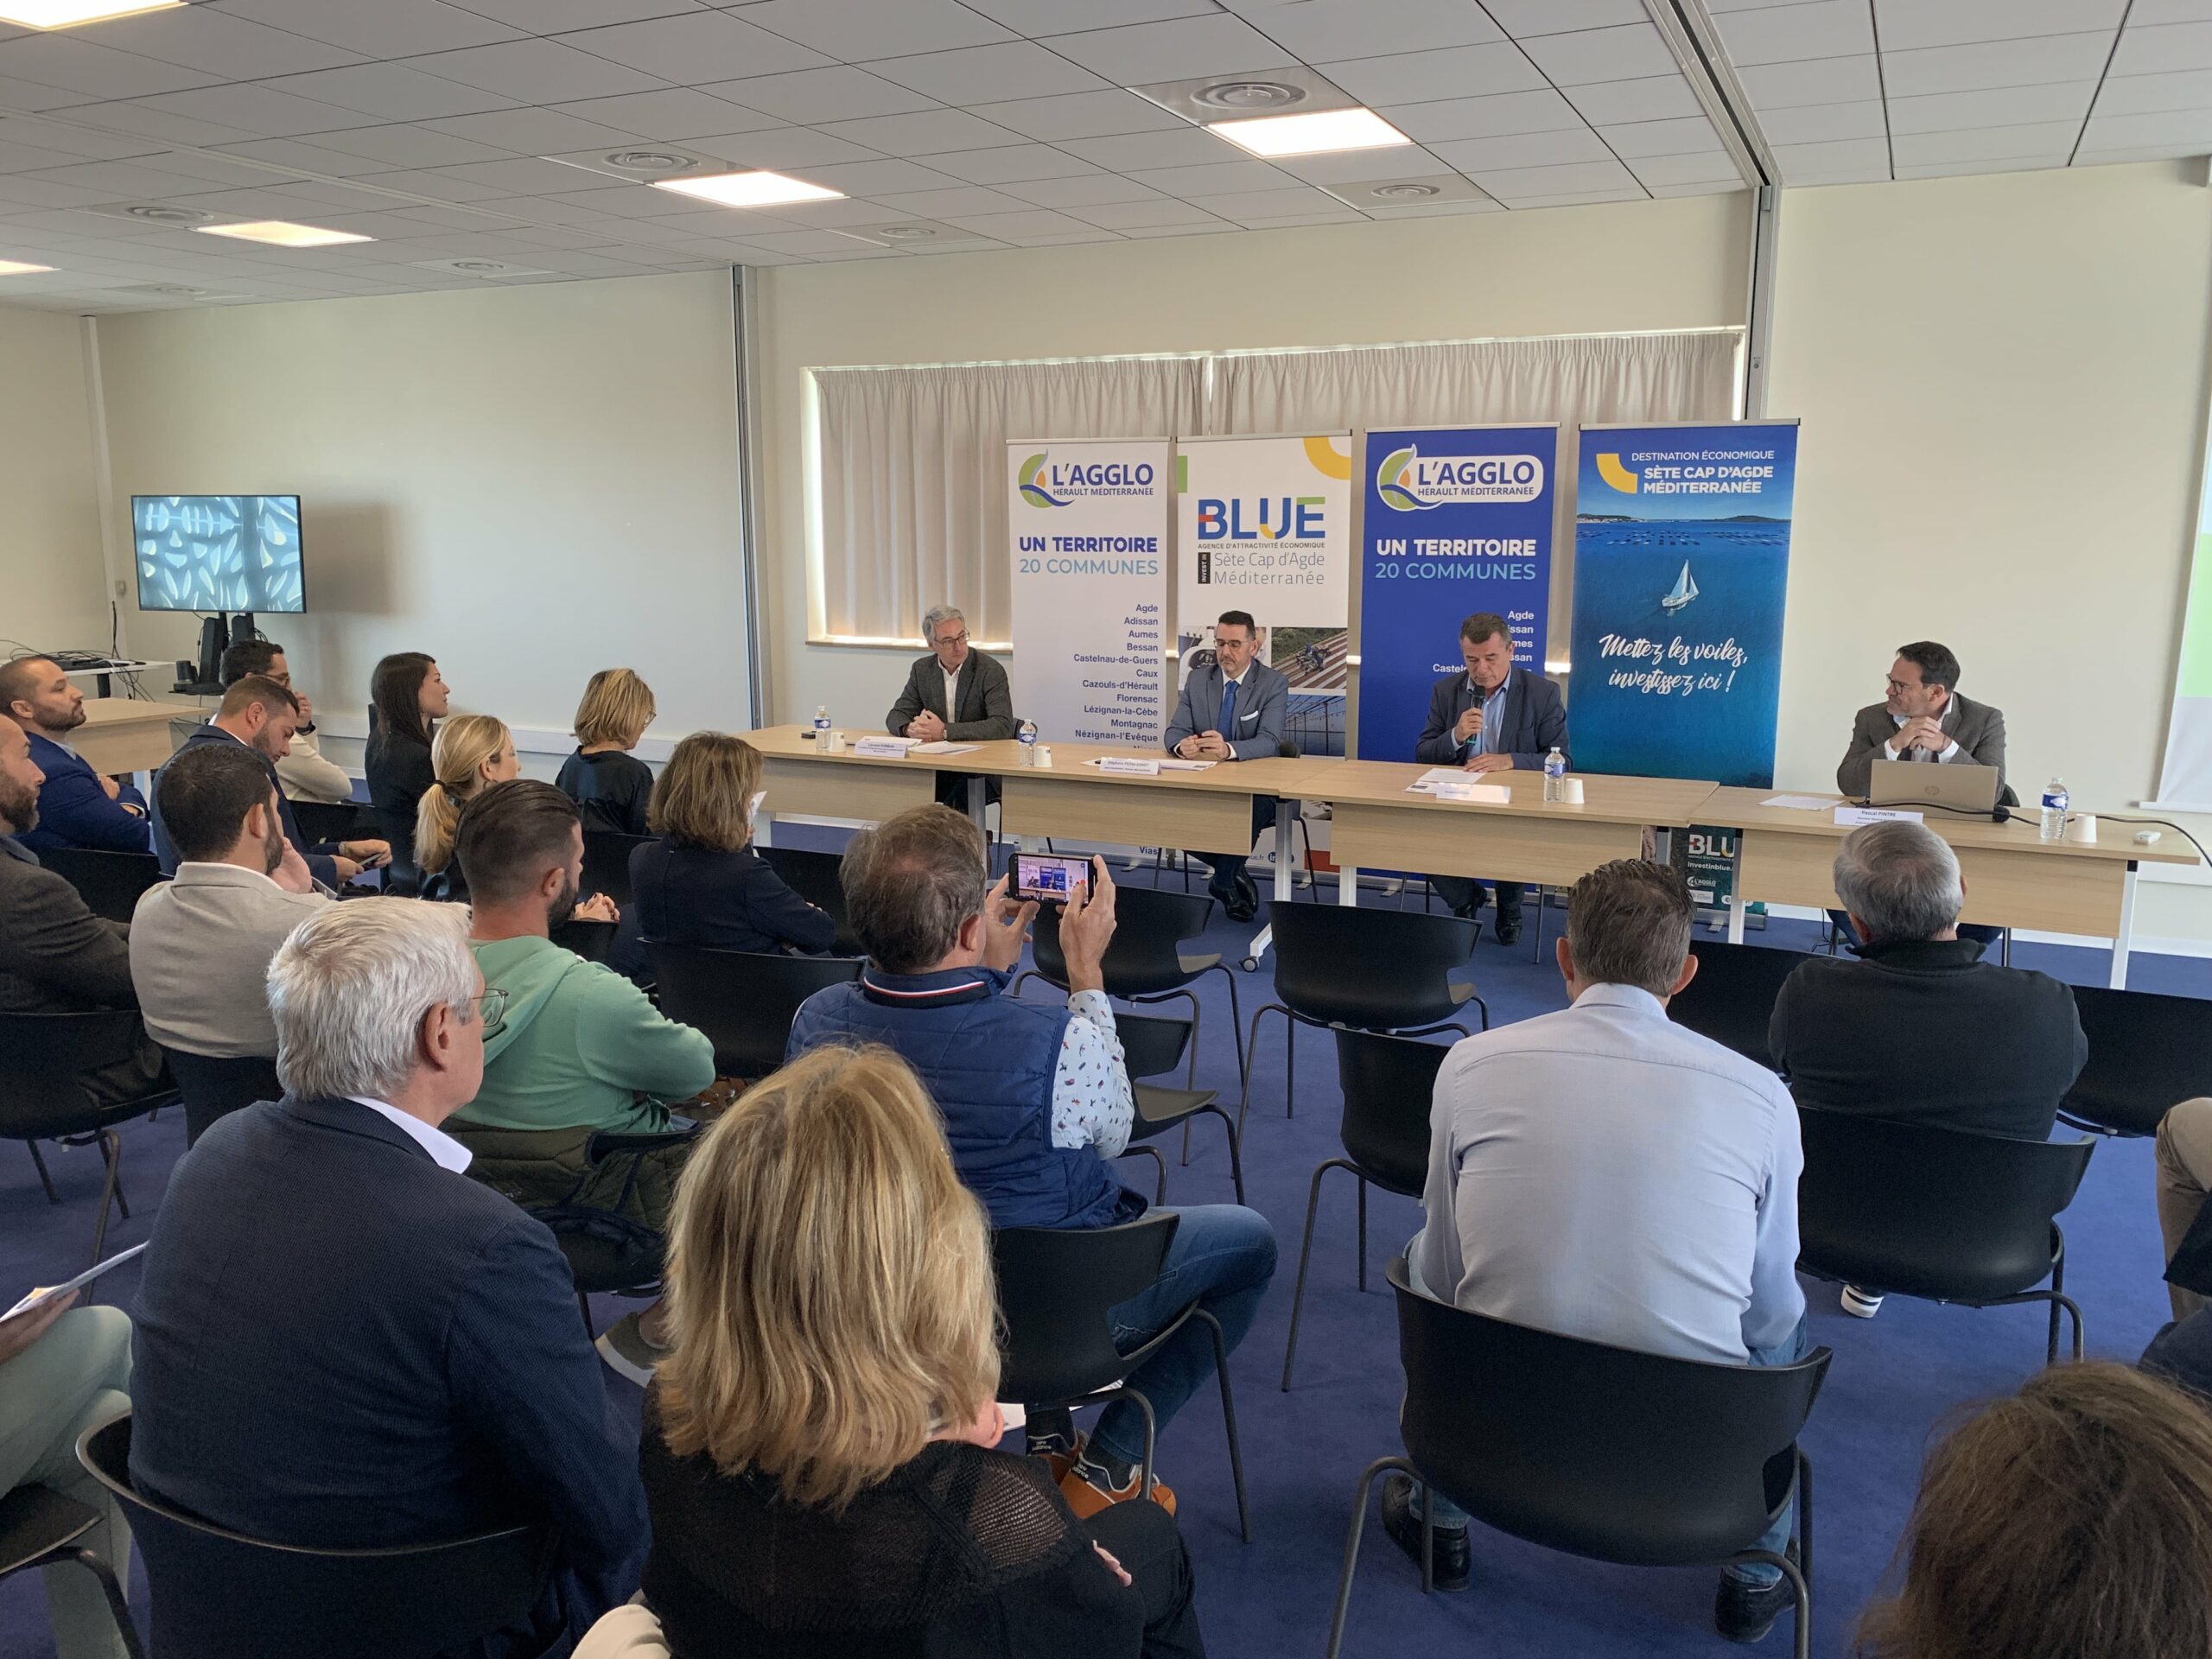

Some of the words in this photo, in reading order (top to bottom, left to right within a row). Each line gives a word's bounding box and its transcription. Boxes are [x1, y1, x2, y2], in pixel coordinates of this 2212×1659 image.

[1631, 451, 1700, 461] DESTINATION
[1701, 449, 1775, 461] ÉCONOMIQUE
[1052, 463, 1154, 486] L'AGGLO
[1418, 461, 1535, 486] L'AGGLO
[1644, 465, 1681, 479] SÈTE
[1684, 467, 1715, 479] CAP
[1718, 466, 1774, 479] D'AGDE
[1643, 480, 1763, 494] MÉDITERRANÉE
[1198, 497, 1326, 540] BLUE
[1020, 537, 1046, 551] UN
[1052, 537, 1158, 553] TERRITOIRE
[1376, 539, 1407, 556] UN
[1413, 539, 1536, 556] TERRITOIRE
[1019, 558, 1041, 574] 20
[1046, 558, 1159, 575] COMMUNES
[1214, 552, 1245, 567] Sète
[1249, 553, 1274, 569] Cap
[1278, 551, 1325, 570] d'Agde
[1214, 570, 1325, 585] Méditerranée
[1375, 562, 1400, 579] 20
[1405, 563, 1536, 581] COMMUNES
[1135, 604, 1159, 613] Agde
[1124, 617, 1159, 626] Adissan
[1508, 610, 1535, 621] Agde
[1128, 630, 1159, 639] Aumes
[1127, 643, 1159, 652] Bessan
[1599, 633, 1665, 665] Mettez
[1668, 636, 1691, 665] les
[1694, 638, 1748, 668] voiles,
[1073, 653, 1159, 664] Castelnau-de-Guers
[1136, 669, 1159, 677] Caux
[1082, 679, 1159, 690] Cazouls-d'Hérault
[1608, 669, 1696, 696] investissez
[1698, 672, 1722, 690] ici
[1725, 670, 1736, 693] !
[1116, 694, 1159, 703] Florensac
[1084, 705, 1159, 716] Lézignan-la-Cèbe
[1110, 719, 1159, 729] Montagnac
[1075, 729, 1159, 742] Nézignan-l'Evêque
[1139, 846, 1158, 855] Vias
[1688, 834, 1735, 858] BLU
